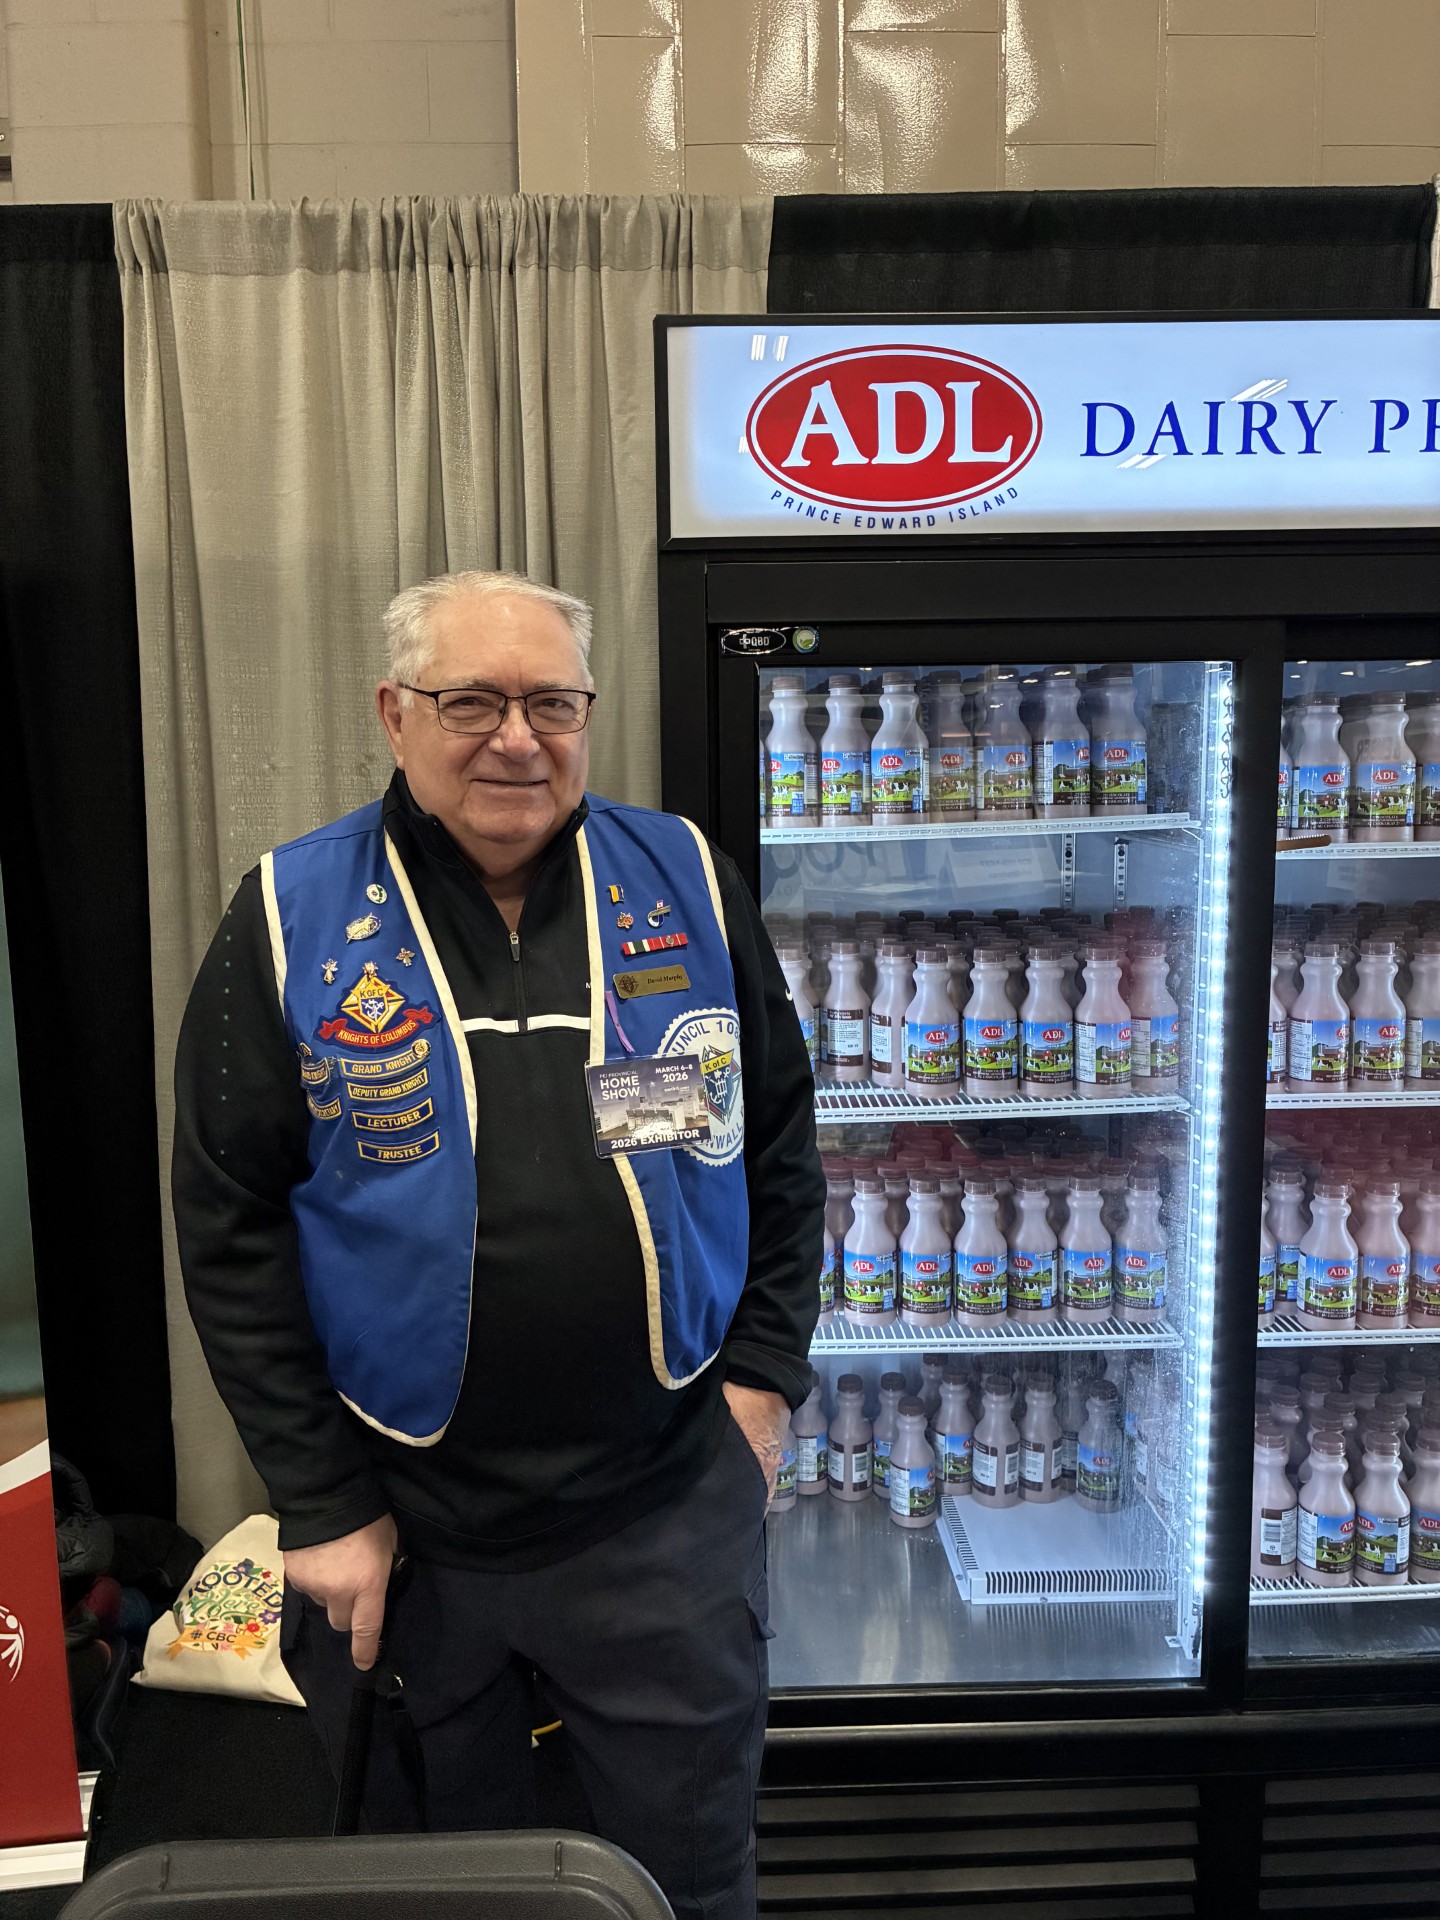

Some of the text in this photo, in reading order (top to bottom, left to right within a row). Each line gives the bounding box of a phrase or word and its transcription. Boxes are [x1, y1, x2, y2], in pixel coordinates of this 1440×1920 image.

[782, 379, 1014, 468] ADL
[1080, 399, 1338, 457] DAIRY
[771, 486, 1019, 530] PRINCE EDWARD ISLAND
[751, 636, 770, 647] QBD
[1106, 749, 1127, 758] ADL
[881, 757, 901, 766] ADL
[943, 756, 962, 765] ADL
[822, 762, 839, 770] ADL
[1375, 771, 1397, 780] ADL
[337, 1019, 416, 1044] KNIGHTS OF COLUMBUS
[928, 1032, 947, 1041] ADL
[983, 1028, 1004, 1037] ADL
[1044, 1031, 1065, 1041] ADL
[351, 1052, 416, 1074] GRAND KNIGHT
[704, 1063, 711, 1071] K
[720, 1057, 727, 1065] C
[655, 1065, 679, 1075] MARCH
[662, 1071, 689, 1083] 2026
[352, 1074, 425, 1097] DEPUTY GRAND KNIGHT
[600, 1075, 640, 1090] HOME
[601, 1086, 641, 1101] SHOW
[367, 1110, 421, 1128] LECTURER
[610, 1129, 700, 1149] 2026 EXHIBITOR
[377, 1145, 423, 1160] TRUSTEE
[854, 1261, 873, 1271] ADL
[1013, 1258, 1032, 1268] ADL
[1087, 1259, 1105, 1268] ADL
[1126, 1256, 1146, 1266] ADL
[918, 1263, 938, 1271] ADL
[975, 1264, 994, 1272] ADL
[1329, 1267, 1349, 1276] ADL
[206, 1630, 237, 1643] CBC
